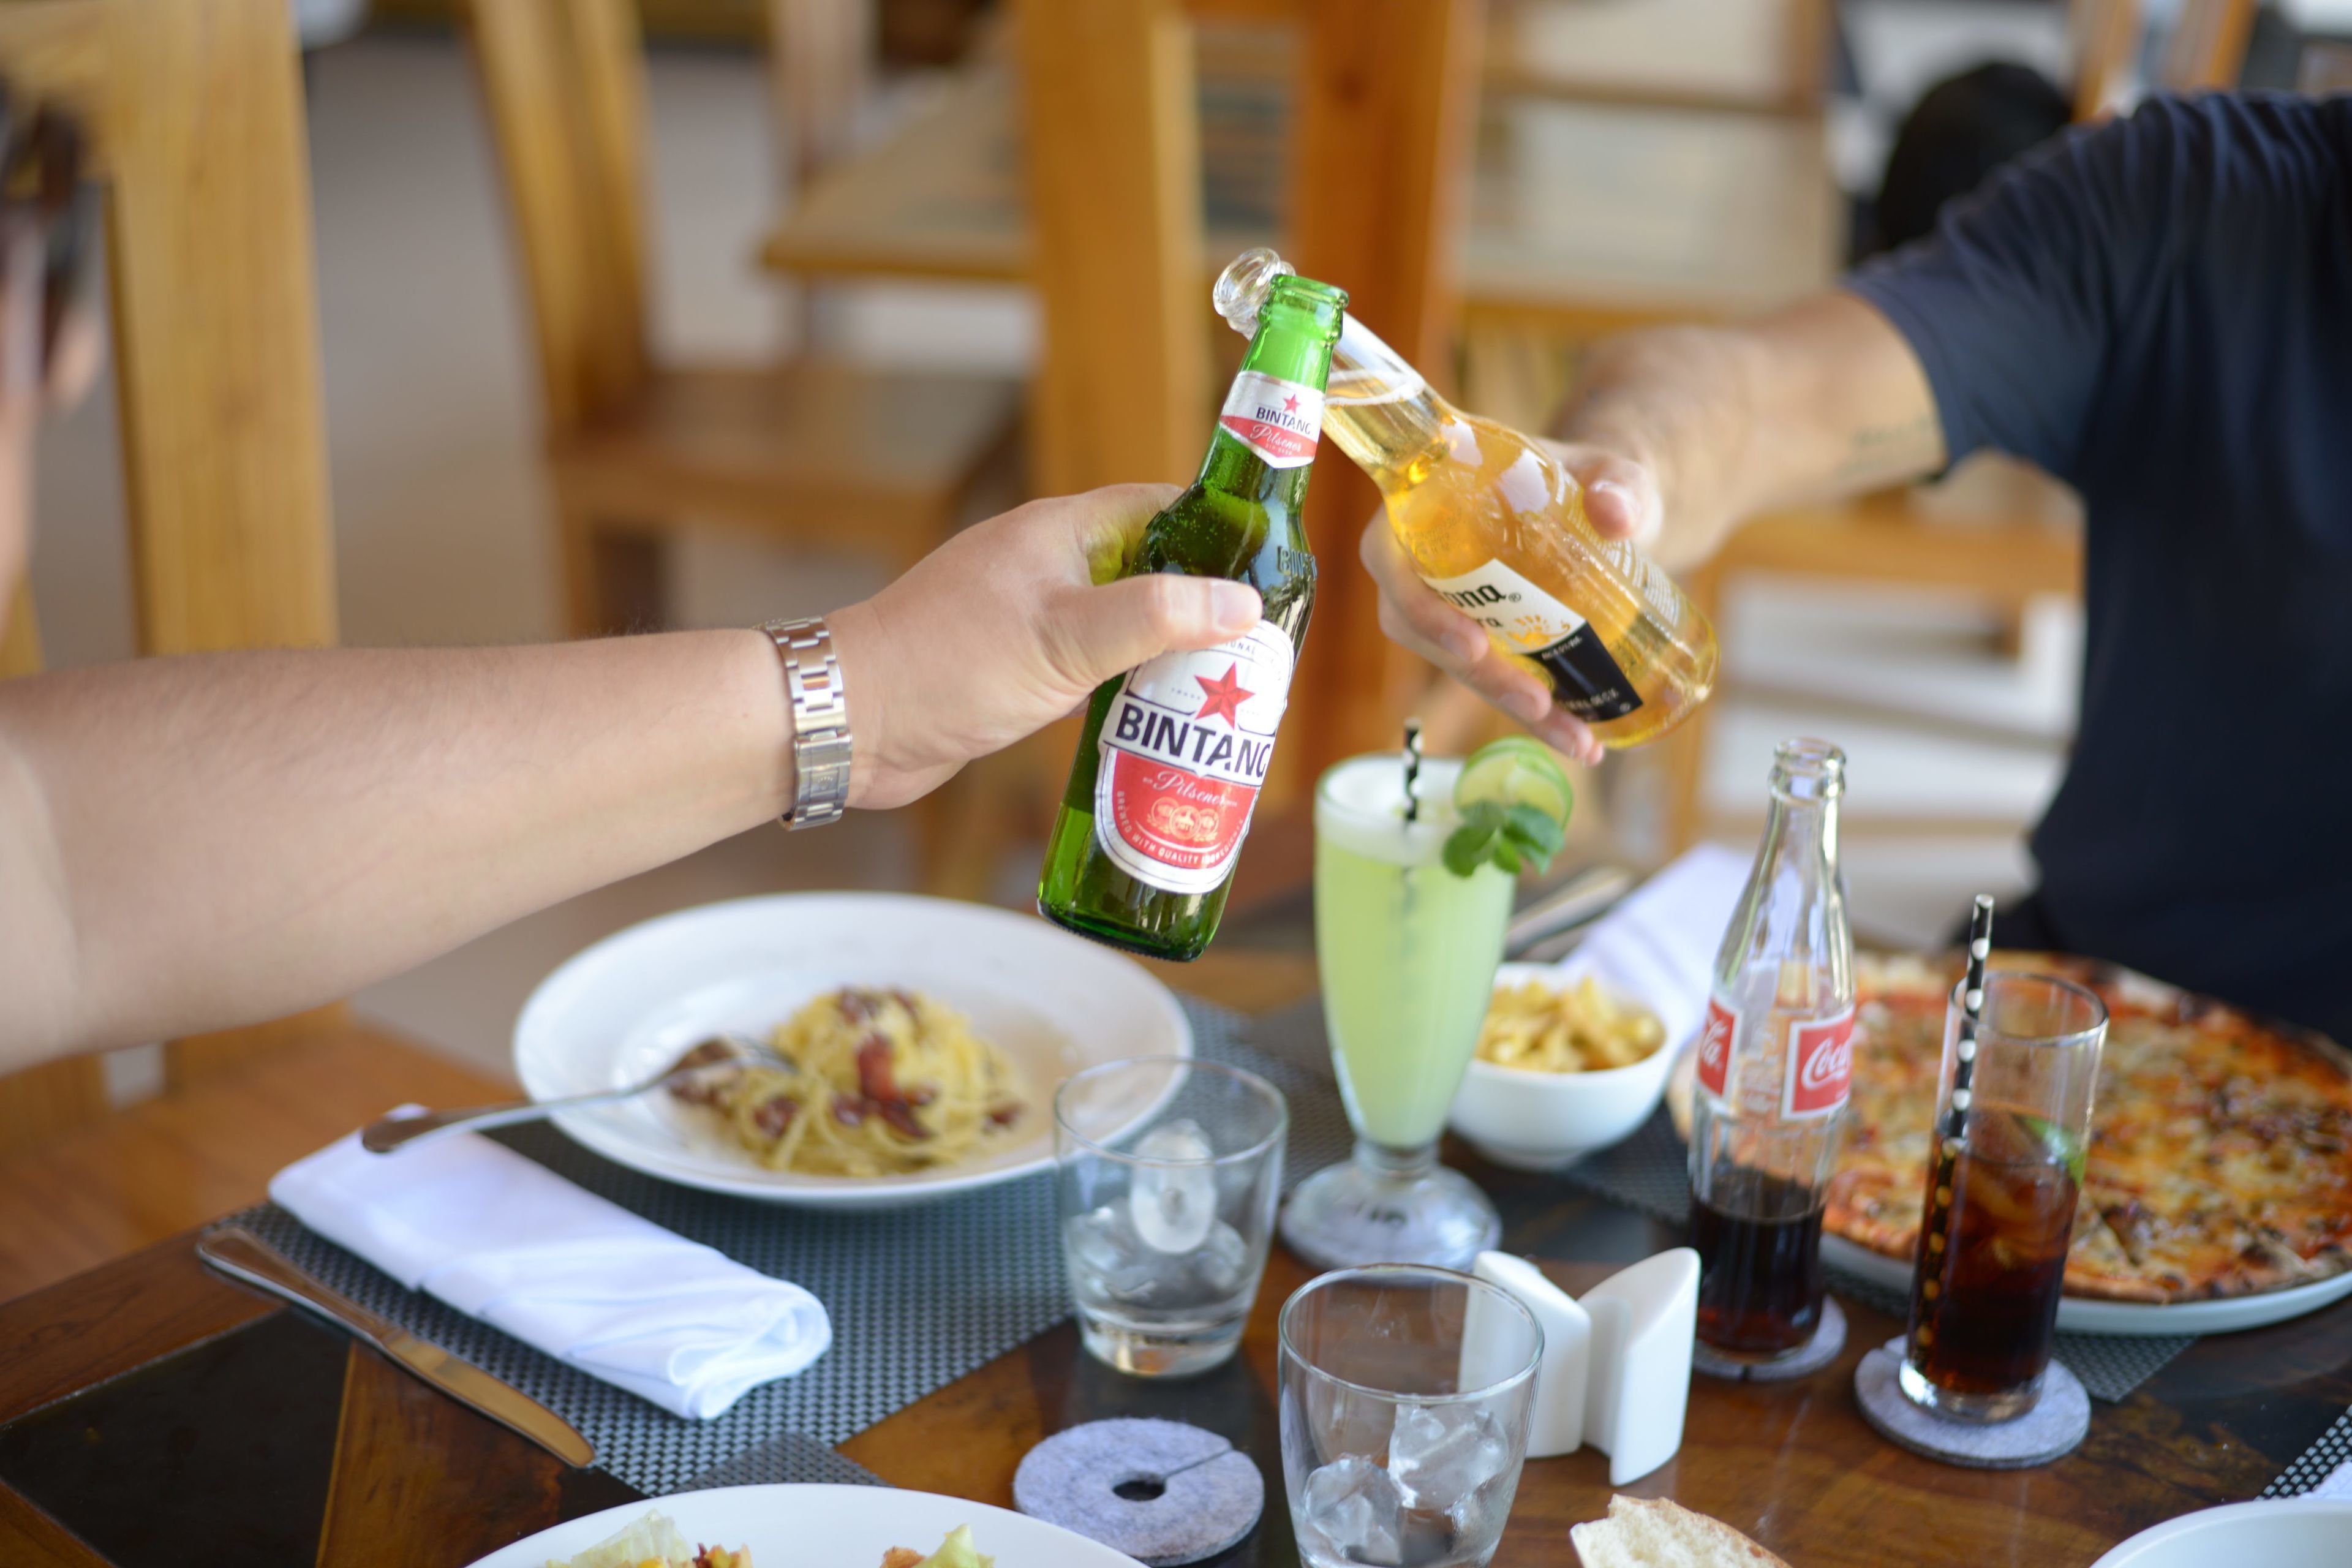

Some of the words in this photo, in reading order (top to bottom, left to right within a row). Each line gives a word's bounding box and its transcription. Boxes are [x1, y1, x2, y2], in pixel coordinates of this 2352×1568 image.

[1115, 702, 1271, 778] BINTANG
[1132, 832, 1156, 853] WITH
[1158, 847, 1199, 864] QUALITY
